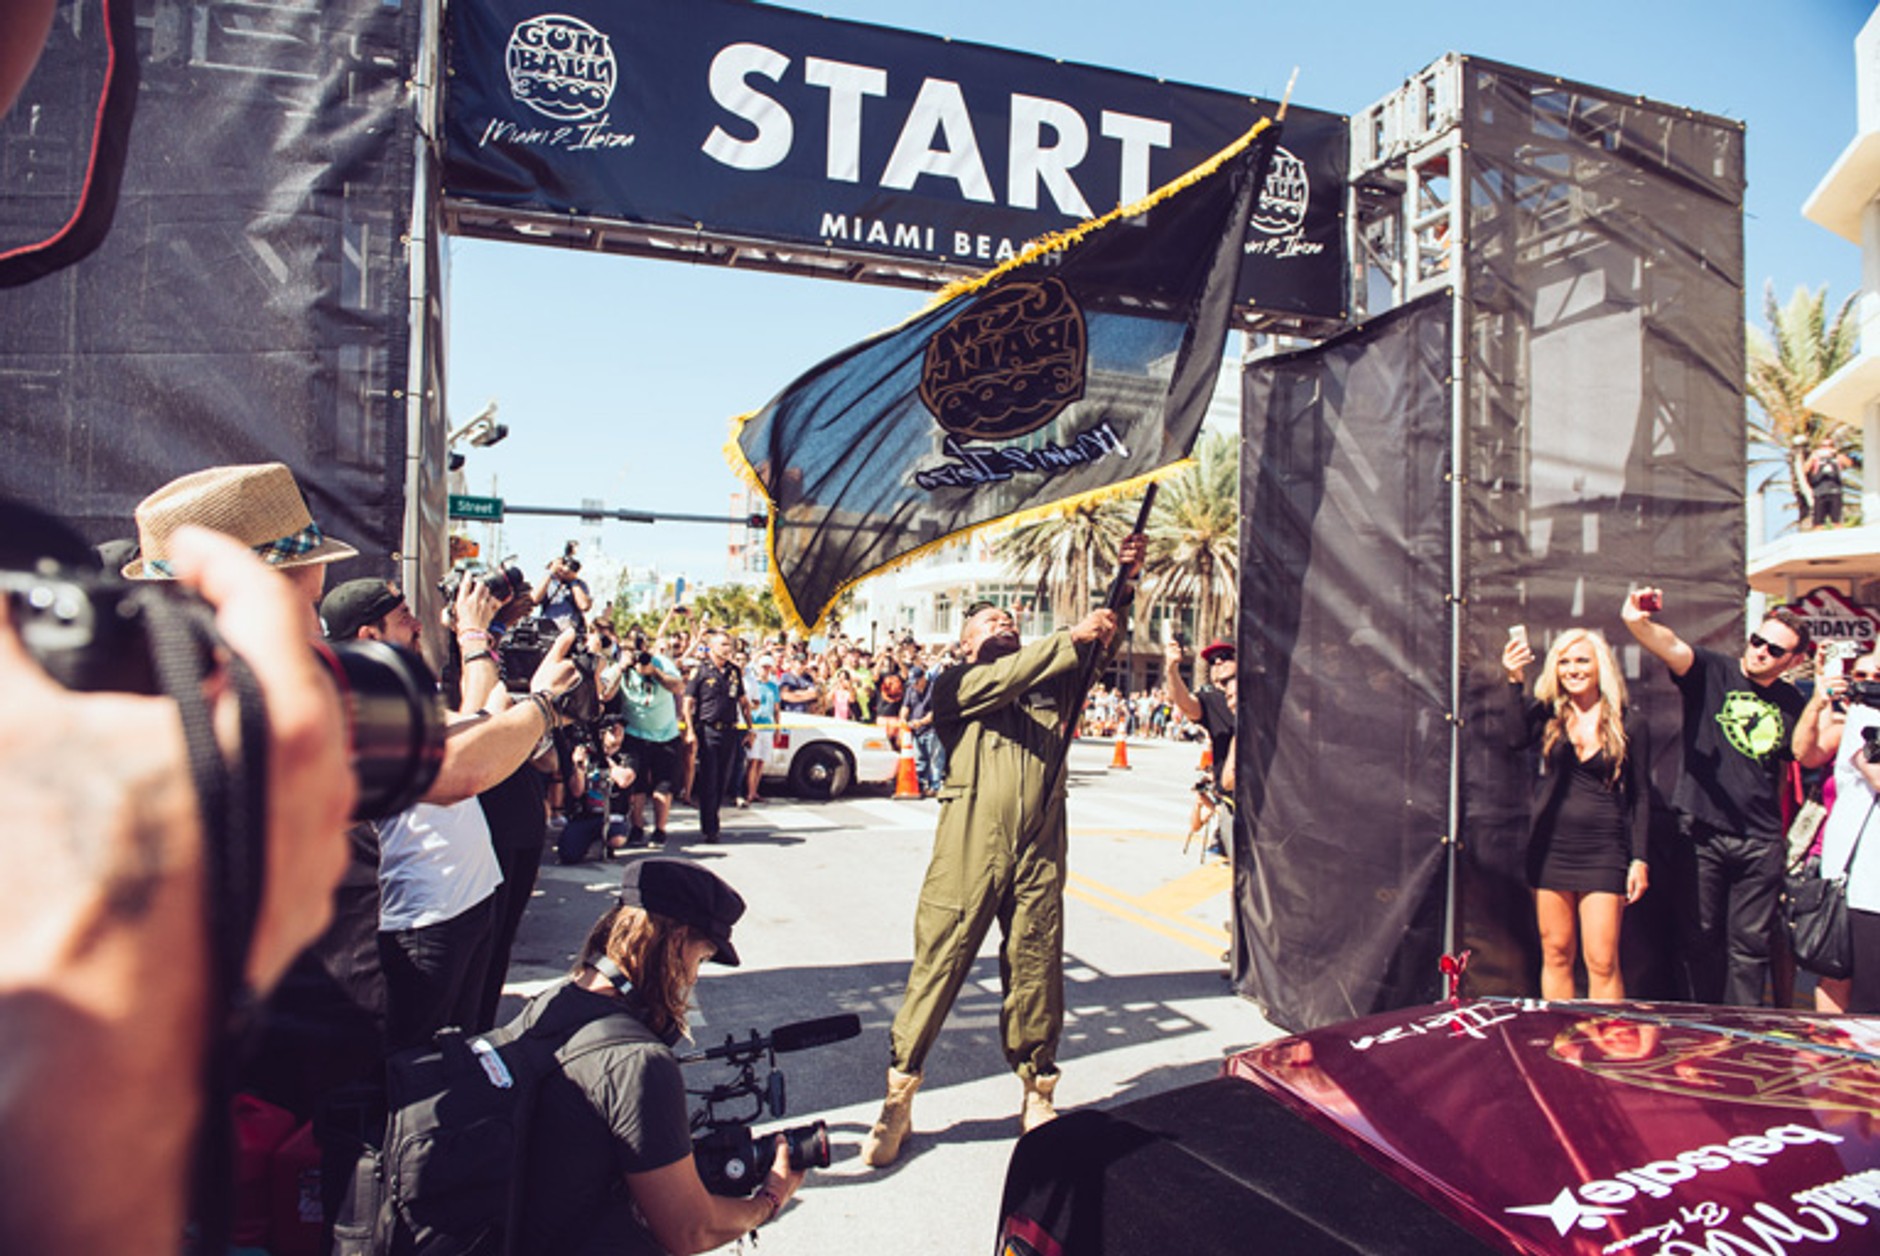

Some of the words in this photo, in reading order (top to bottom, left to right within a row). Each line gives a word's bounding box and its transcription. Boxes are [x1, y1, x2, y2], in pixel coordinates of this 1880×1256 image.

[701, 42, 1172, 228] START
[819, 213, 935, 251] MIAMI
[456, 500, 494, 514] Street
[1579, 1124, 1844, 1204] betsafe
